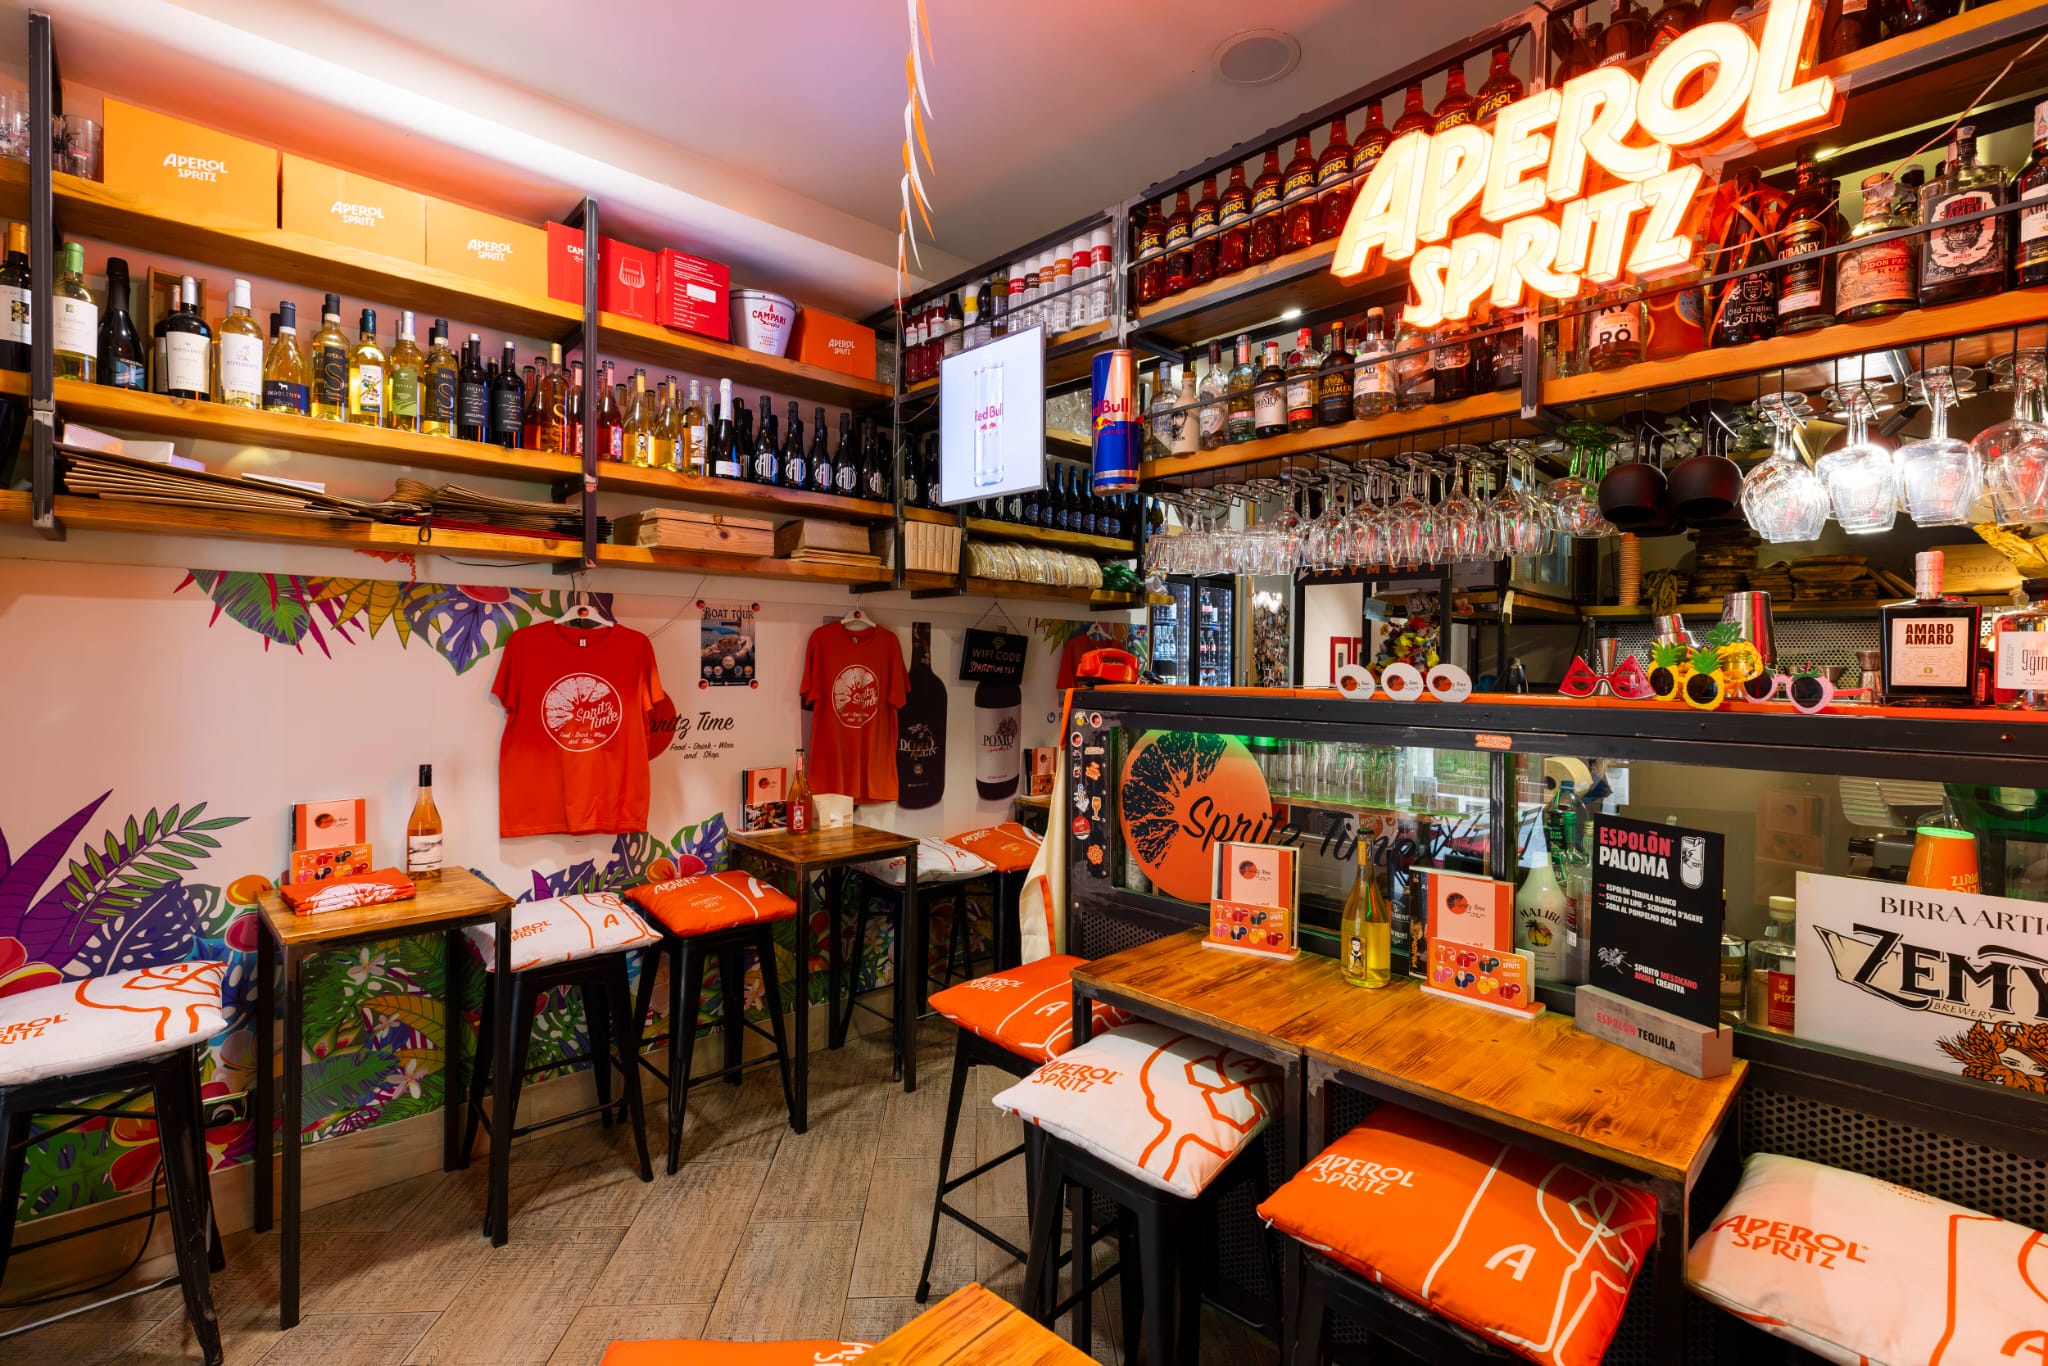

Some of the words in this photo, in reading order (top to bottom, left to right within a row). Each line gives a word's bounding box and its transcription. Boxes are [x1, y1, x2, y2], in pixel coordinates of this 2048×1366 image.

[1331, 0, 1836, 279] APEROL
[163, 153, 228, 174] APEROL
[331, 201, 384, 219] APEROL
[467, 238, 513, 254] APEROL
[752, 310, 786, 325] CAMPARI
[828, 338, 855, 349] APEROL
[1102, 398, 1128, 414] Bull
[703, 606, 728, 619] BOAT
[731, 609, 754, 620] TOUR
[1905, 623, 1954, 635] AMARO
[1905, 634, 1954, 645] AMARO
[972, 648, 994, 658] WIFI
[996, 651, 1022, 663] CODE
[575, 701, 613, 723] Spritz
[589, 711, 619, 731] Time
[696, 712, 734, 731] Time
[1182, 796, 1304, 853] Spritz
[1599, 845, 1669, 879] PALOMA
[1605, 893, 1622, 903] SUCCO
[1630, 898, 1643, 908] LIME
[1647, 903, 1677, 916] SCIROPPO
[1631, 890, 1654, 901] TEQUILA
[1654, 895, 1677, 907] BLANCO
[1519, 907, 1561, 925] MALIBU
[1605, 902, 1620, 912] SODA
[1660, 916, 1677, 927] ROSA
[1880, 896, 1967, 925] BIRRA
[1634, 963, 1659, 978] SPIRITO
[1656, 978, 1685, 994] CREATIVA
[1932, 1001, 1999, 1020] BREWERY
[1637, 1027, 1676, 1052] TEQUILA
[1039, 1060, 1119, 1085] APEROL
[1304, 1154, 1415, 1188] APEROL
[1713, 1214, 1866, 1264] APEROL
